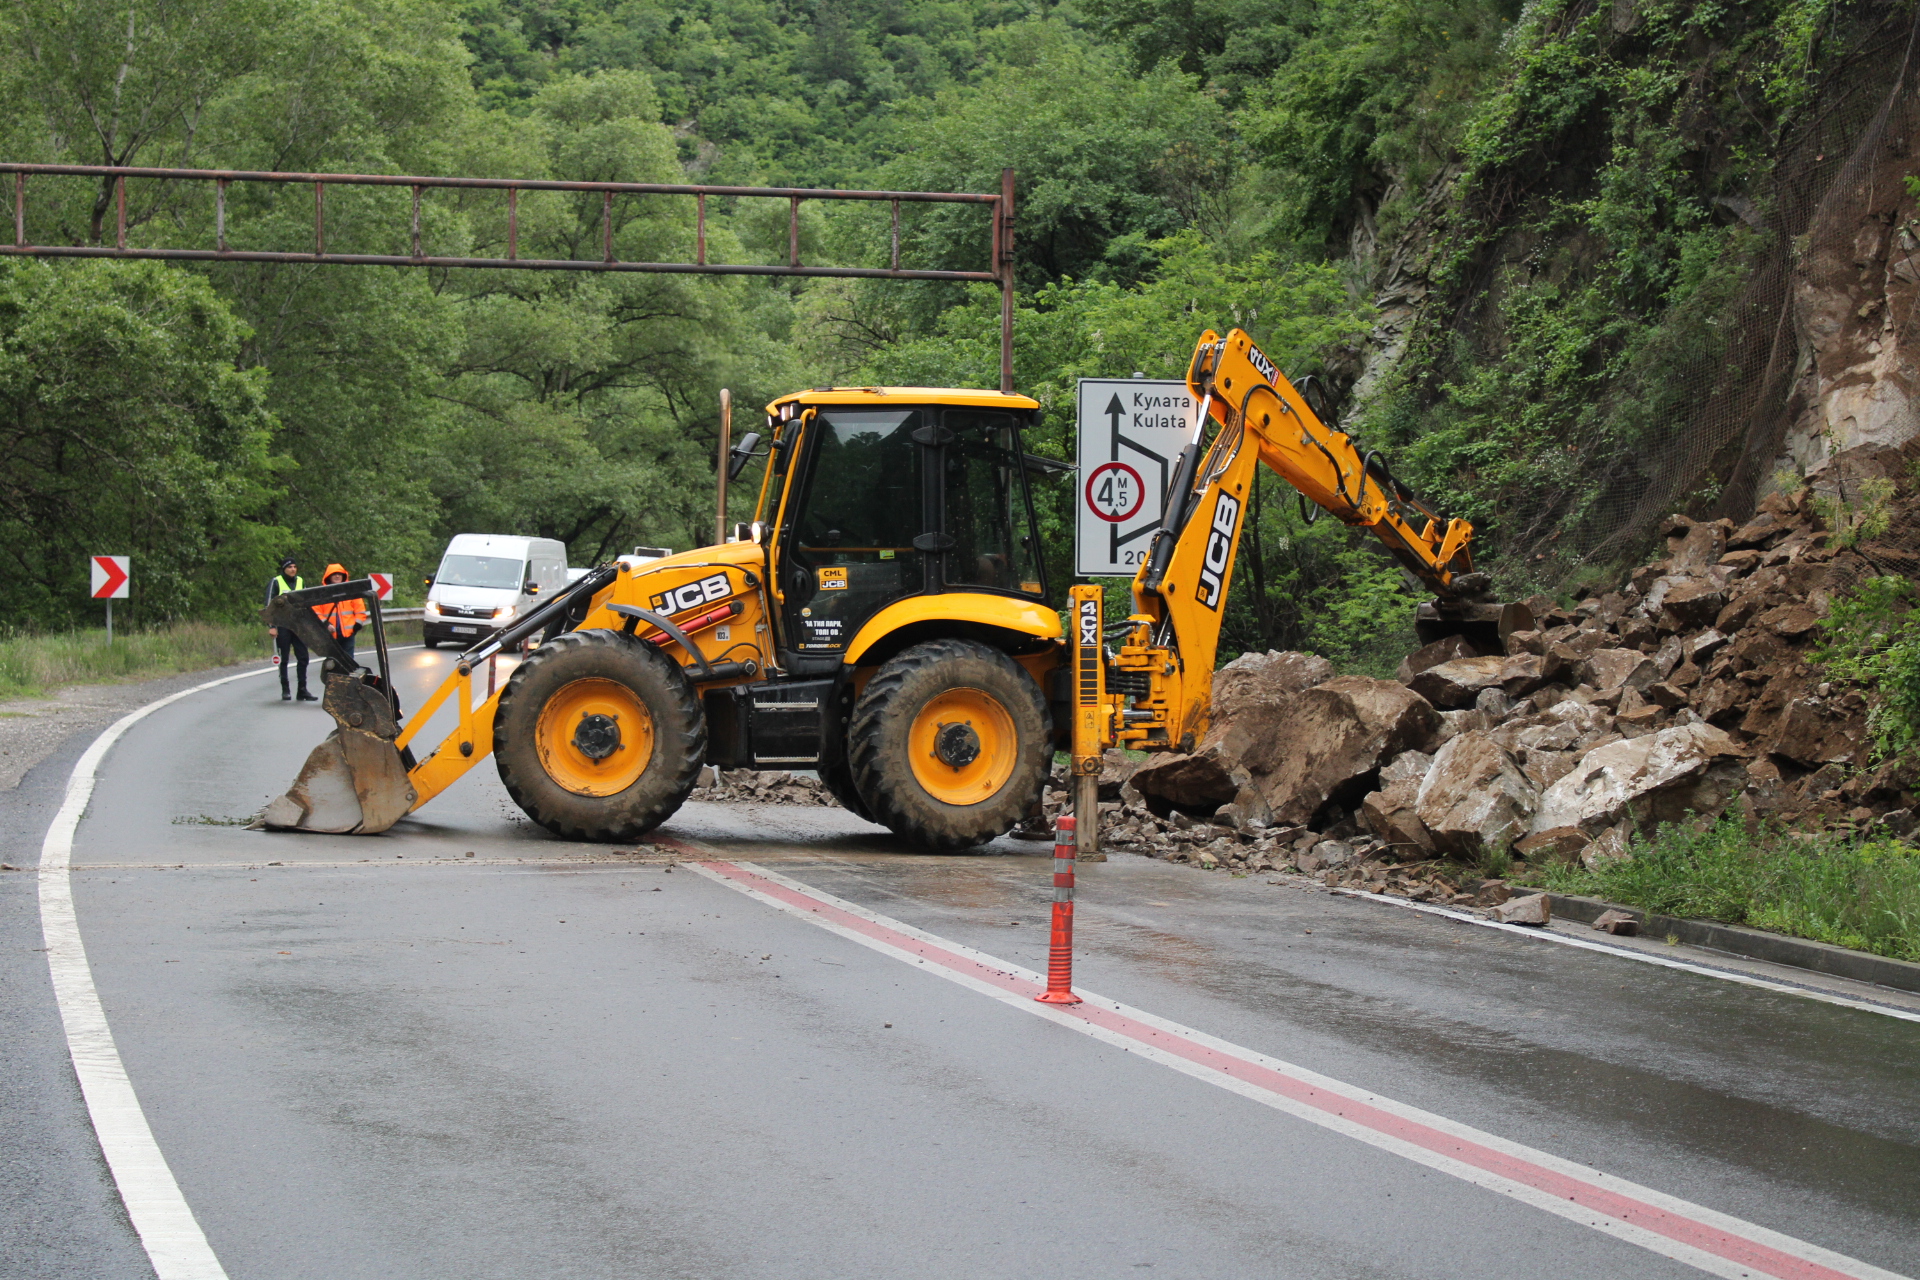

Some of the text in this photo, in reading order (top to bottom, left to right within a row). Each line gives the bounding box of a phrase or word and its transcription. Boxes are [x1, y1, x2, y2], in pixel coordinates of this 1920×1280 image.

[1250, 346, 1274, 381] 4CX
[1133, 392, 1190, 411] Кулата
[1133, 413, 1187, 428] Kulata
[1201, 494, 1238, 607] JCB
[655, 574, 731, 617] JCB
[822, 580, 846, 588] JCB
[717, 631, 726, 640] 103
[1080, 601, 1097, 644] 4CX
